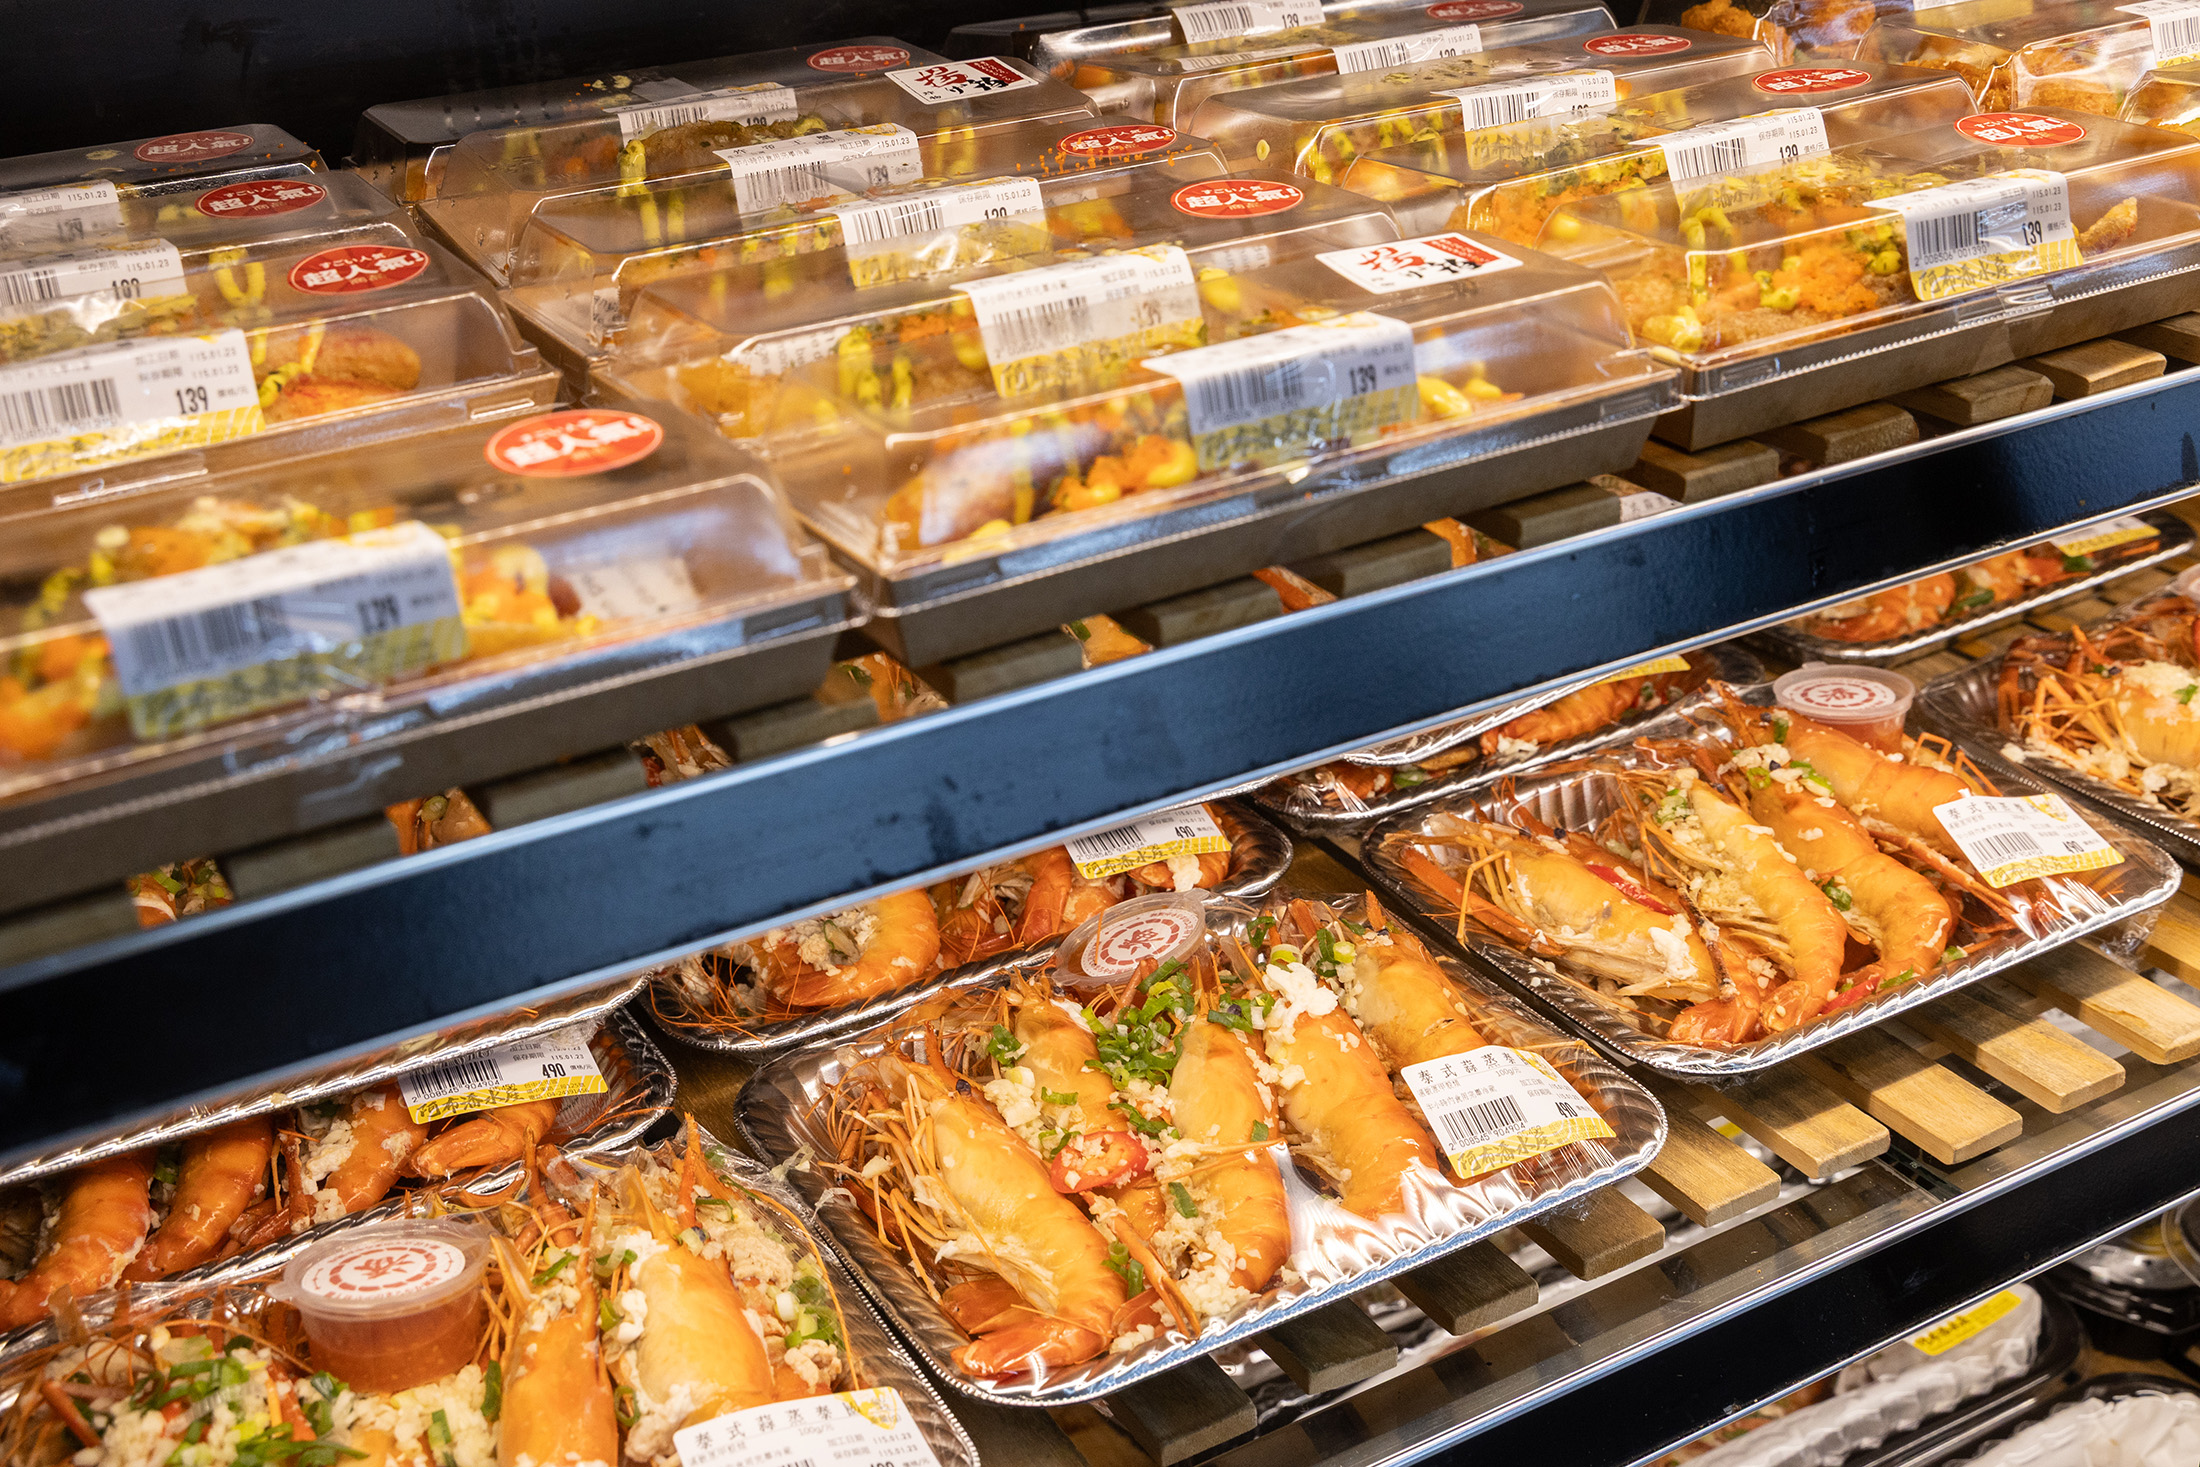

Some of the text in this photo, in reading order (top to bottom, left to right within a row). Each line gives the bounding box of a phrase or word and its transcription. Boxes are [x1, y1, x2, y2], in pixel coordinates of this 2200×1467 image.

[1282, 13, 1300, 29] 139
[1581, 76, 1609, 86] 115.01.23
[1766, 70, 1863, 90] 超人氣!
[1582, 90, 1609, 100] 115.01.23
[1787, 112, 1816, 124] 115.01.23
[1758, 126, 1818, 141] 保存期限 115.01.23
[1973, 117, 2069, 141] 超人氣!
[147, 137, 250, 155] 超人氣!
[839, 137, 910, 150] 加工日期 115.01.23
[1070, 129, 1173, 150] 超人氣!
[23, 190, 108, 203] 加工日期 115.01.23
[209, 186, 322, 213] 超人氣!
[223, 185, 287, 198] すごい人気
[957, 188, 1031, 204] 保存期限 115.01.23
[1186, 187, 1299, 208] 超人氣!
[2032, 186, 2062, 199] 115.01.23
[2032, 203, 2062, 215] 115.01.23
[2022, 220, 2067, 246] 139 價格/元
[319, 252, 387, 269] すごい人気
[1914, 245, 1988, 267] 2 008506 001390
[125, 258, 170, 273] 115.01.23
[302, 252, 425, 287] 超人氣!
[1349, 364, 1378, 396] 139
[176, 386, 209, 415] 139
[1174, 825, 1196, 839] 490
[512, 1052, 545, 1061] 保存期限
[542, 1063, 567, 1079] 490
[423, 1087, 460, 1101] 008545
[464, 1079, 501, 1091] 904904
[416, 1087, 525, 1118] 阿布潘水產
[1555, 1101, 1578, 1118] 490
[1448, 1143, 1456, 1151] 2
[1459, 1134, 1490, 1147] 008545
[1493, 1122, 1526, 1137] 904904
[1457, 1131, 1554, 1173] 阿布潘水產
[872, 1431, 912, 1445] 115.01.23
[878, 1444, 918, 1458] 115.01.23
